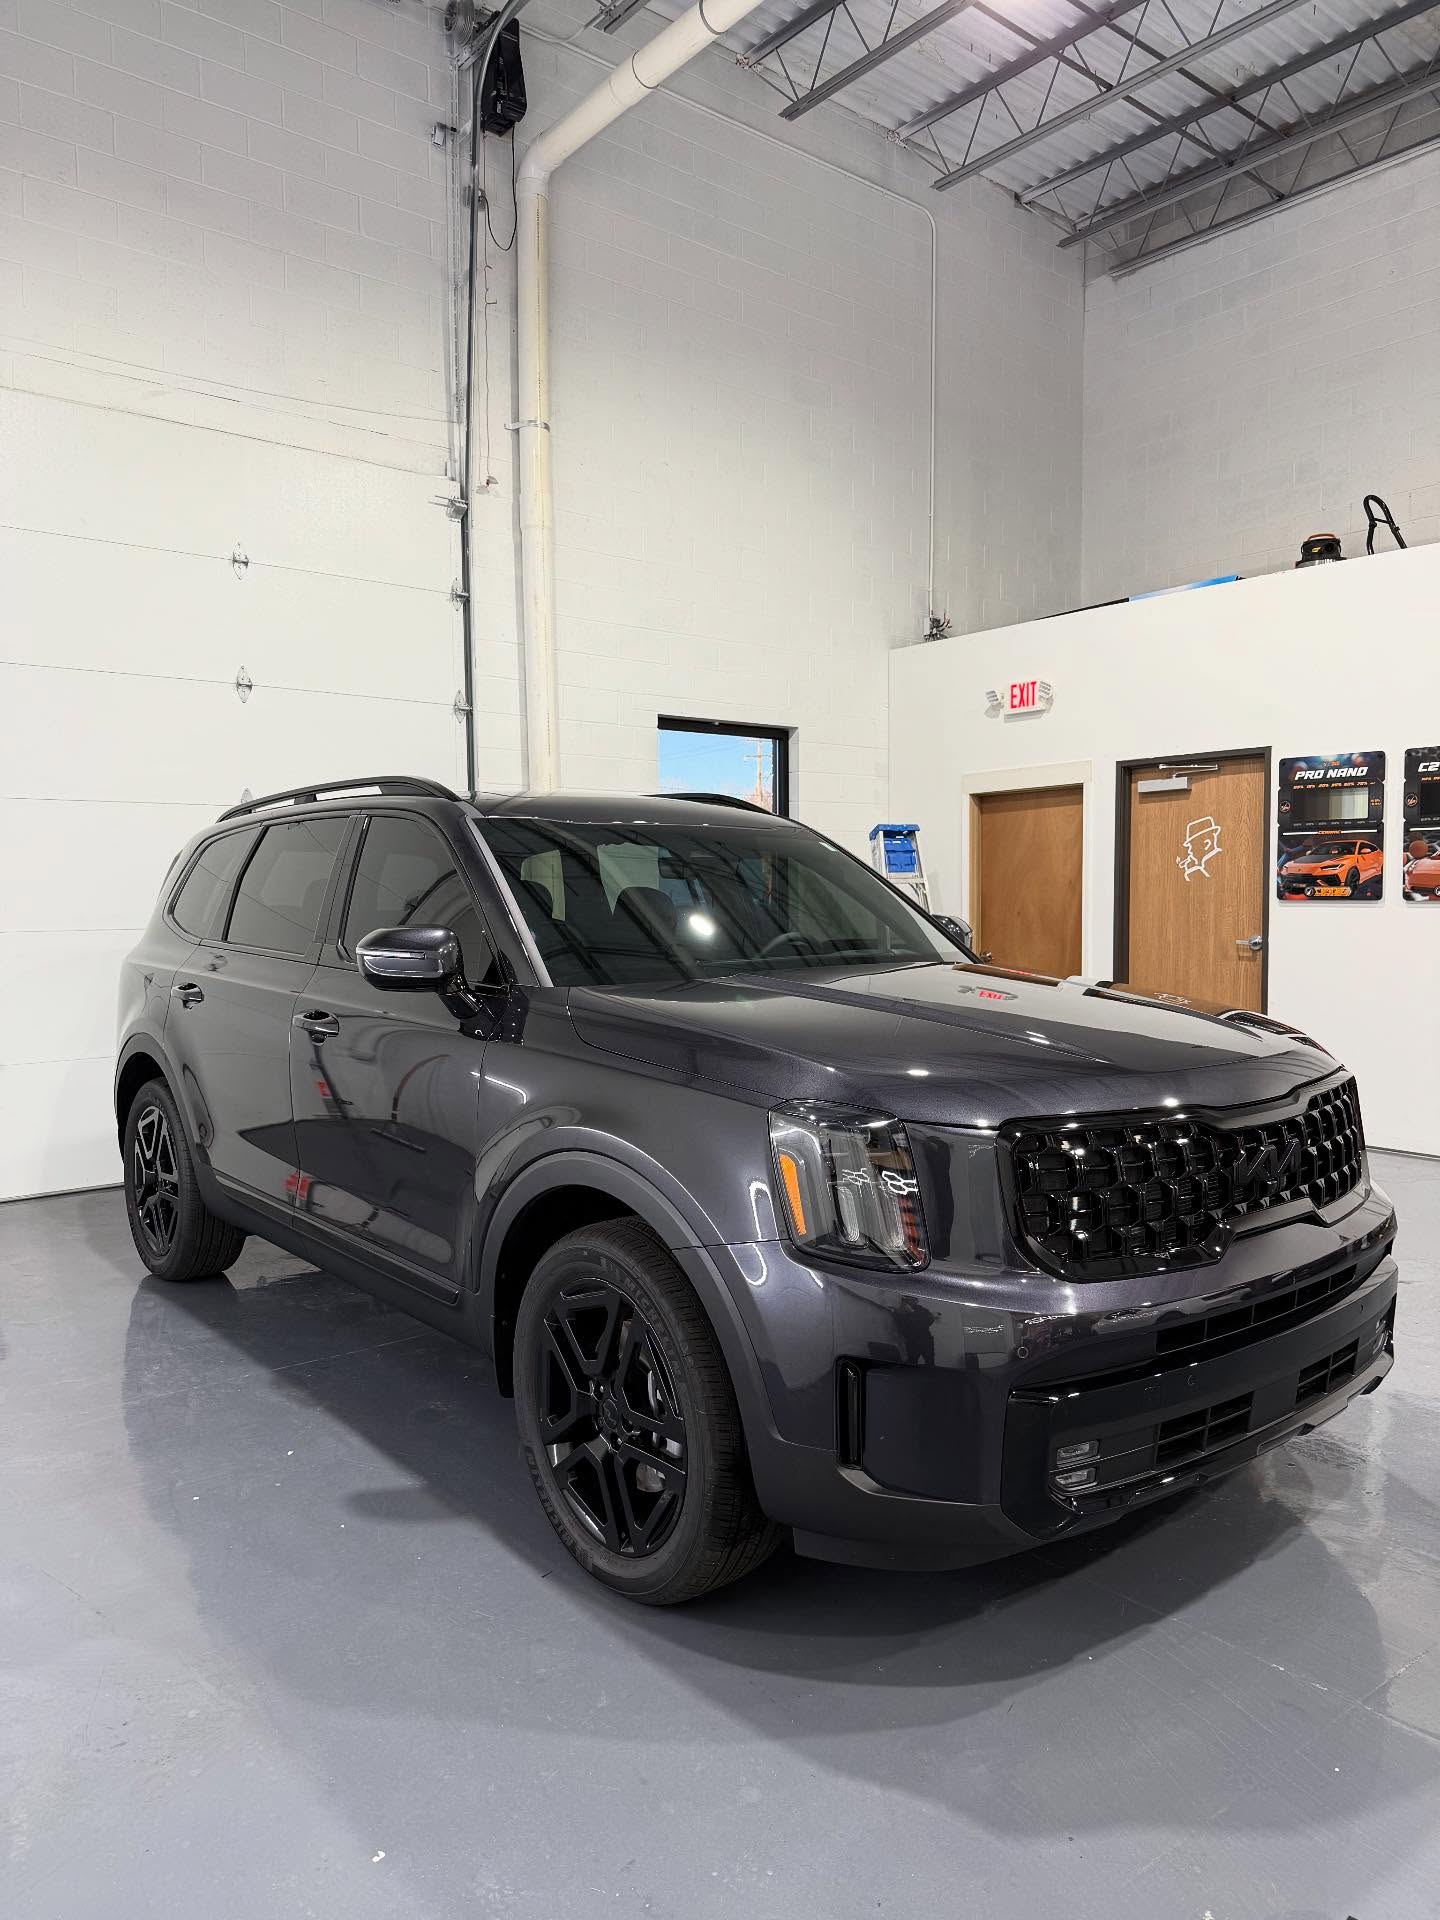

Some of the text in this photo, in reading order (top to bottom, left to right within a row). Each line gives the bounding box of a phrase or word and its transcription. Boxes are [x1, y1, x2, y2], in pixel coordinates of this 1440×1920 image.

[1010, 681, 1037, 709] EXIT
[1295, 767, 1368, 780] PRO NANO
